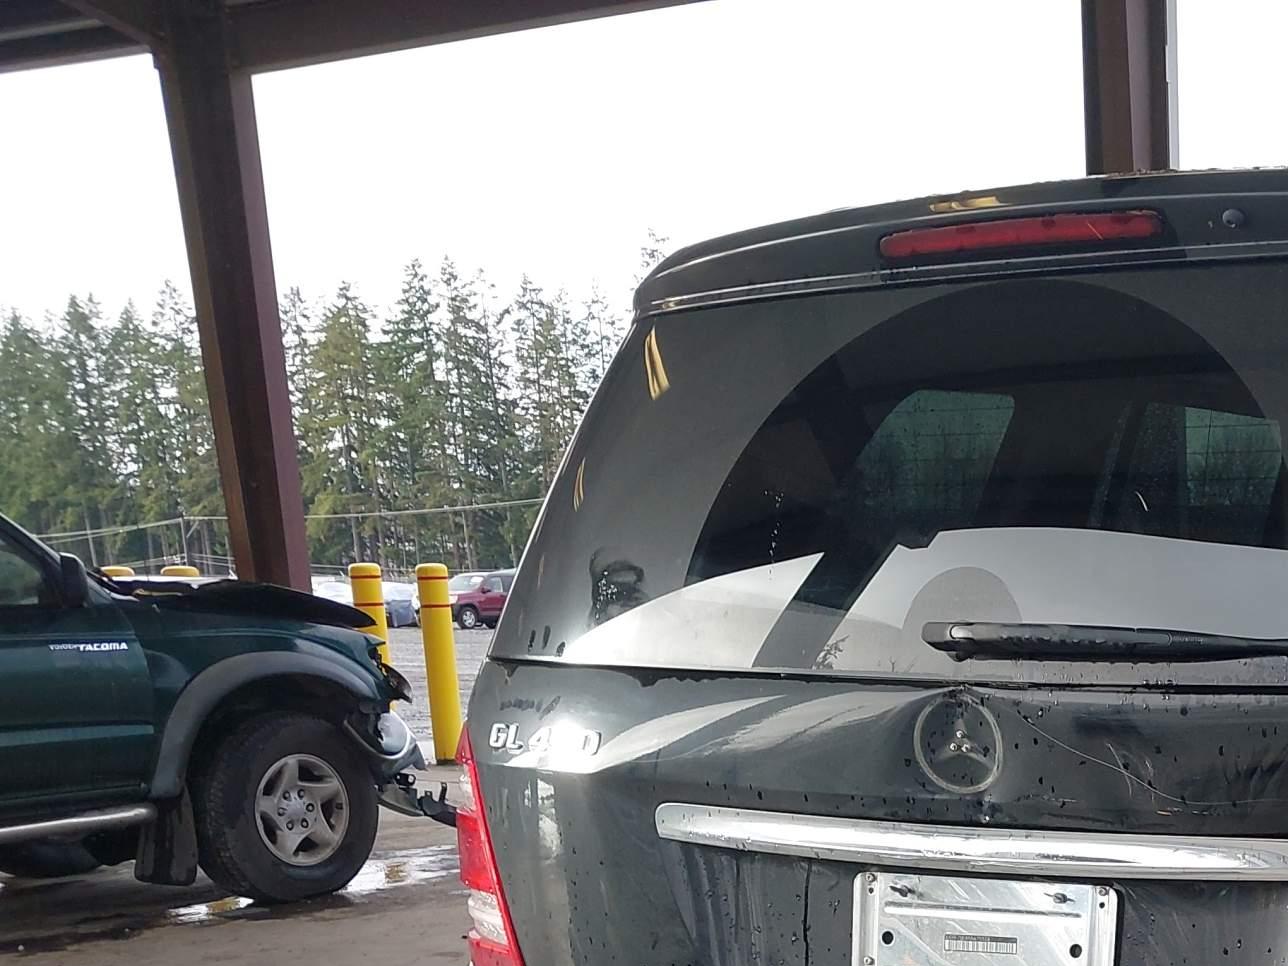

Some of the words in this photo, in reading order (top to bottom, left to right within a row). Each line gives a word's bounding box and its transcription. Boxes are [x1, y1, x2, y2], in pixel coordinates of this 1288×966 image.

[79, 642, 128, 652] TACOMA
[489, 722, 524, 754] GL
[528, 727, 602, 756] 40
